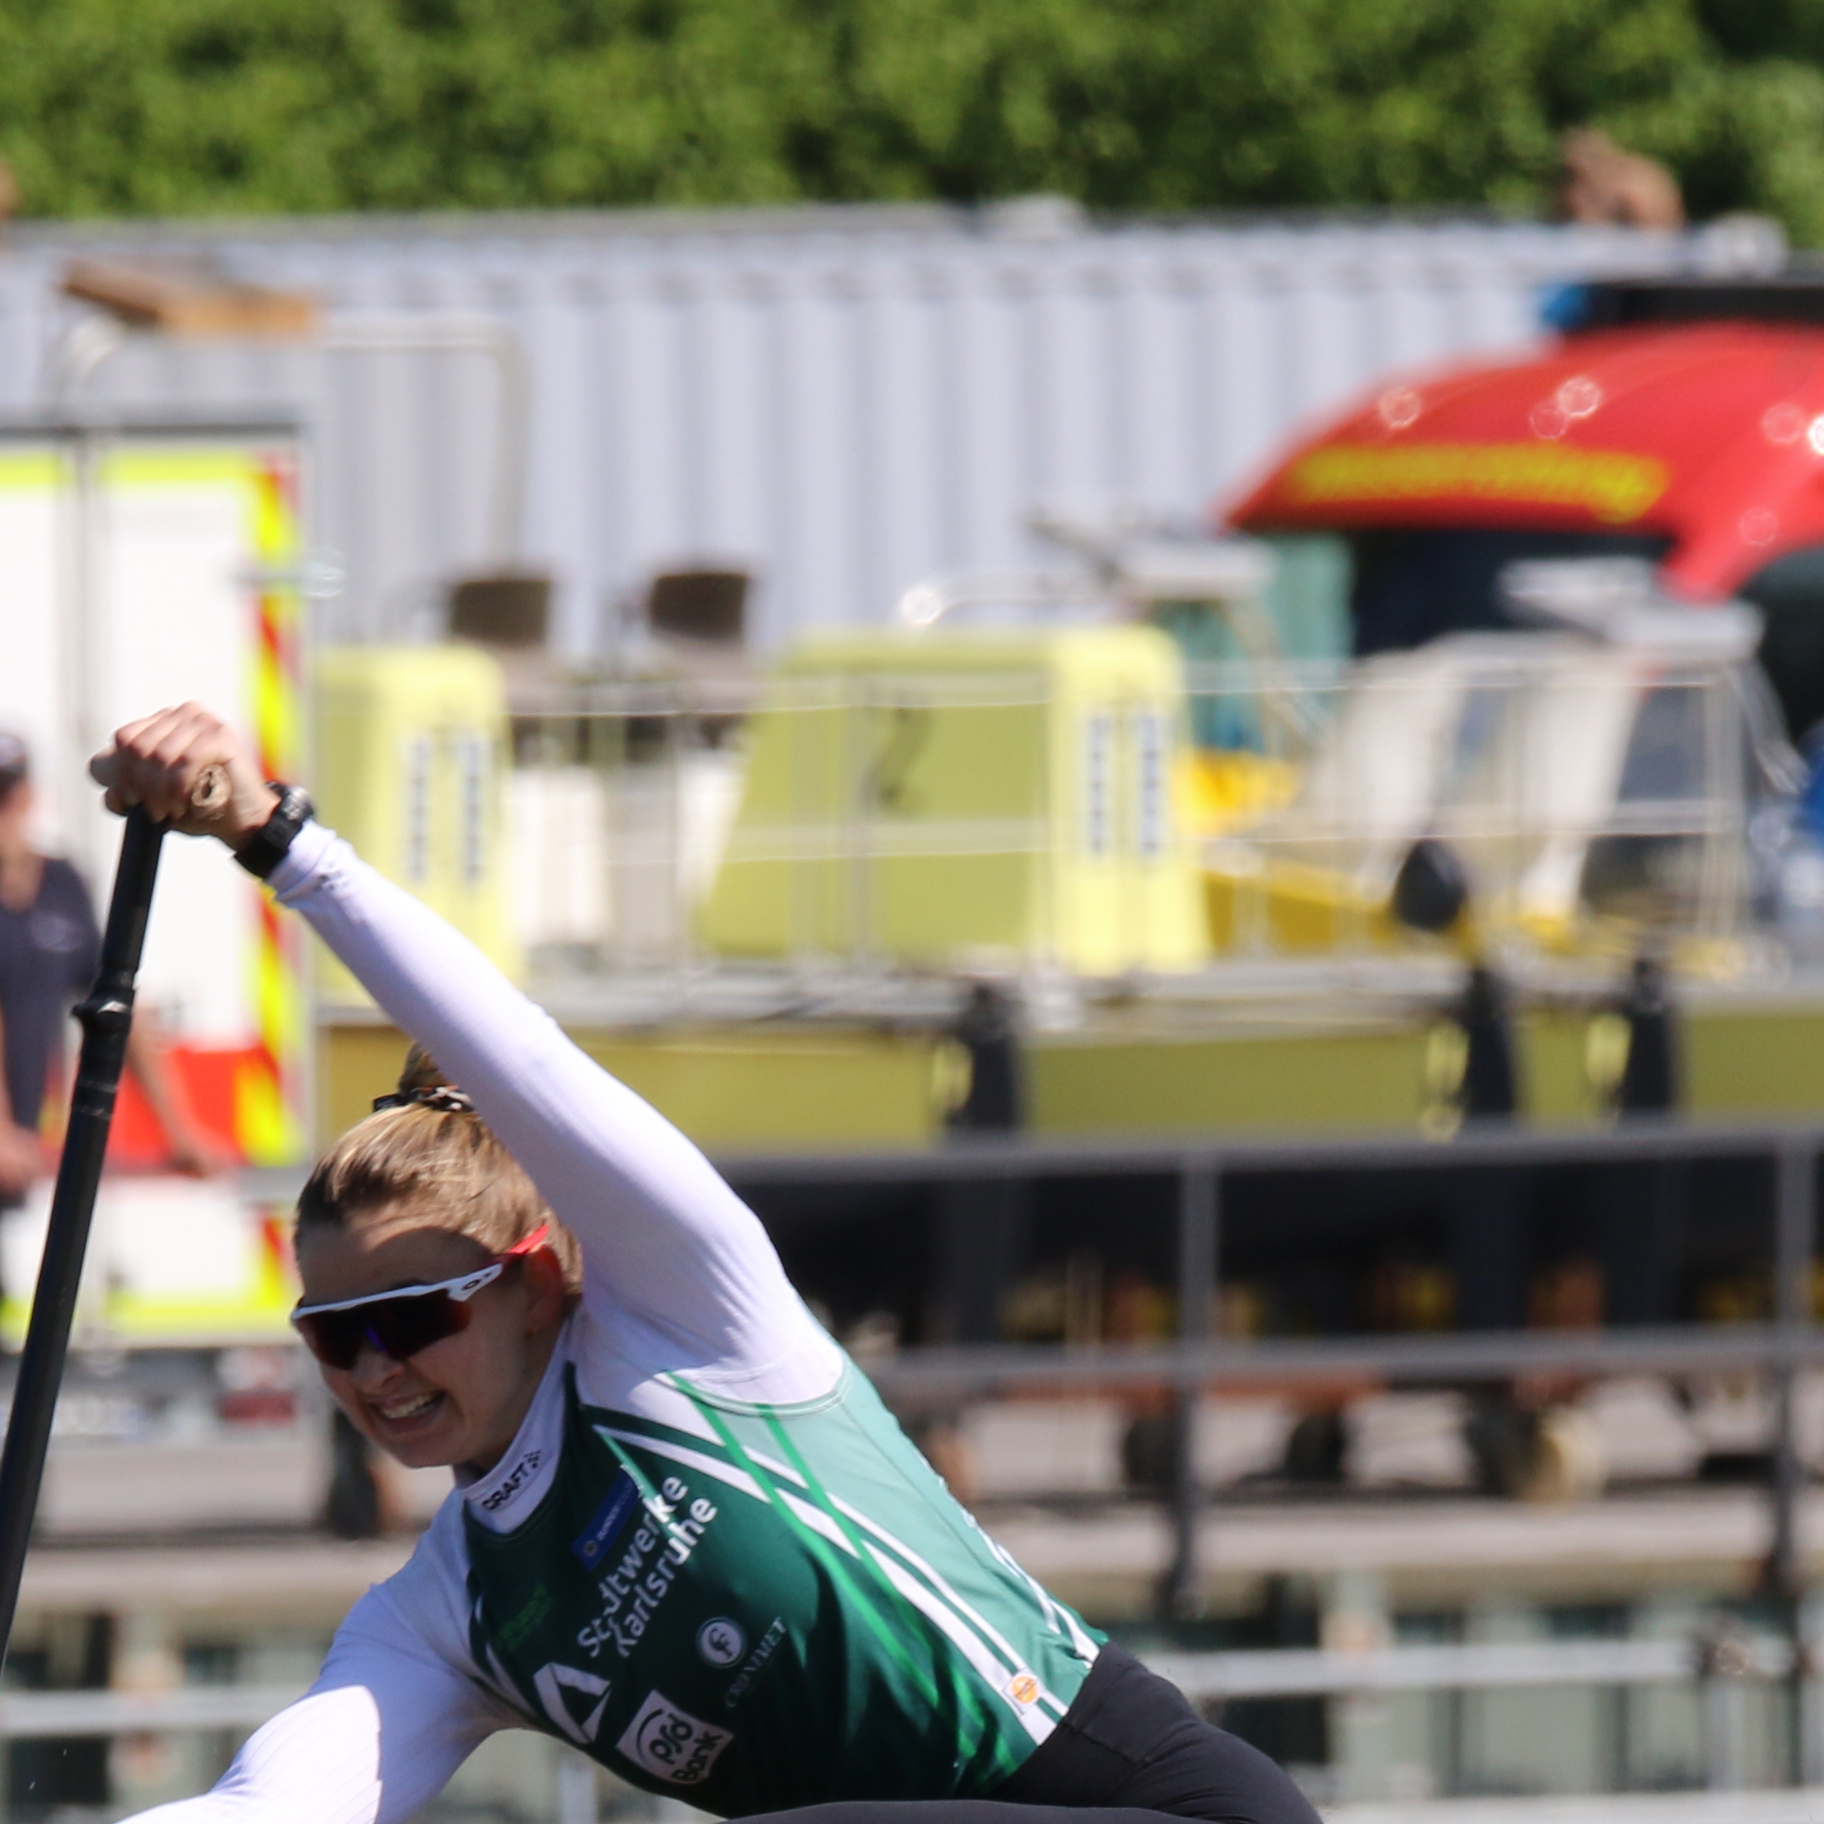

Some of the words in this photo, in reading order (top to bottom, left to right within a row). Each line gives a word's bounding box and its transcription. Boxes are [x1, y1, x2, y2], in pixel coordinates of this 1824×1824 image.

[577, 1475, 689, 1658] Stdtwerke
[607, 1498, 718, 1658] Karlsruhe
[671, 1730, 725, 1782] Bank
